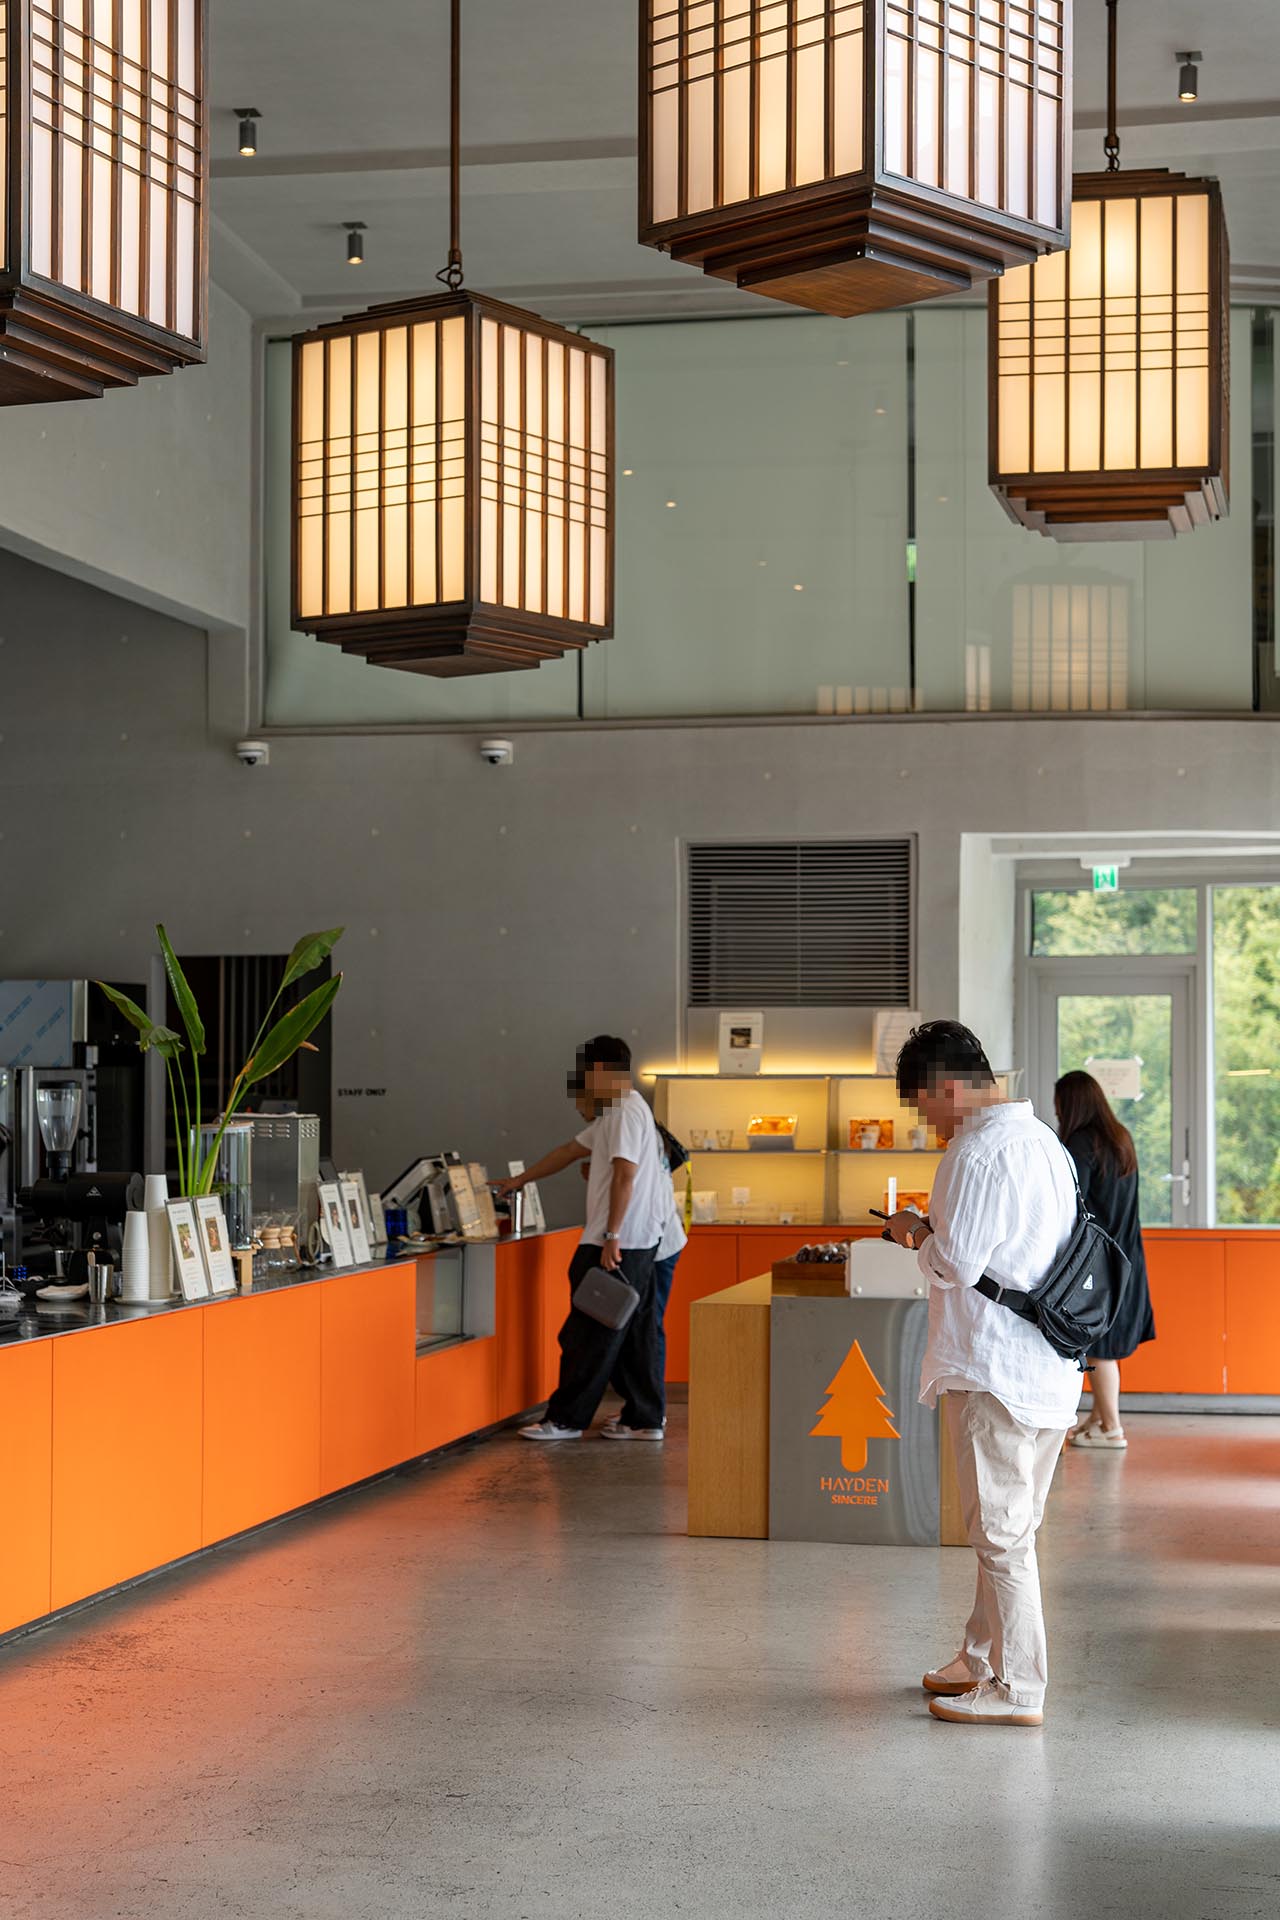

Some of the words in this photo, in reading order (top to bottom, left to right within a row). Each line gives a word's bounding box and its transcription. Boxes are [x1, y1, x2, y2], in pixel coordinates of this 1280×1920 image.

[365, 1088, 387, 1097] ONLY
[820, 1476, 890, 1493] HAYDEN
[831, 1494, 879, 1505] SINCERE
